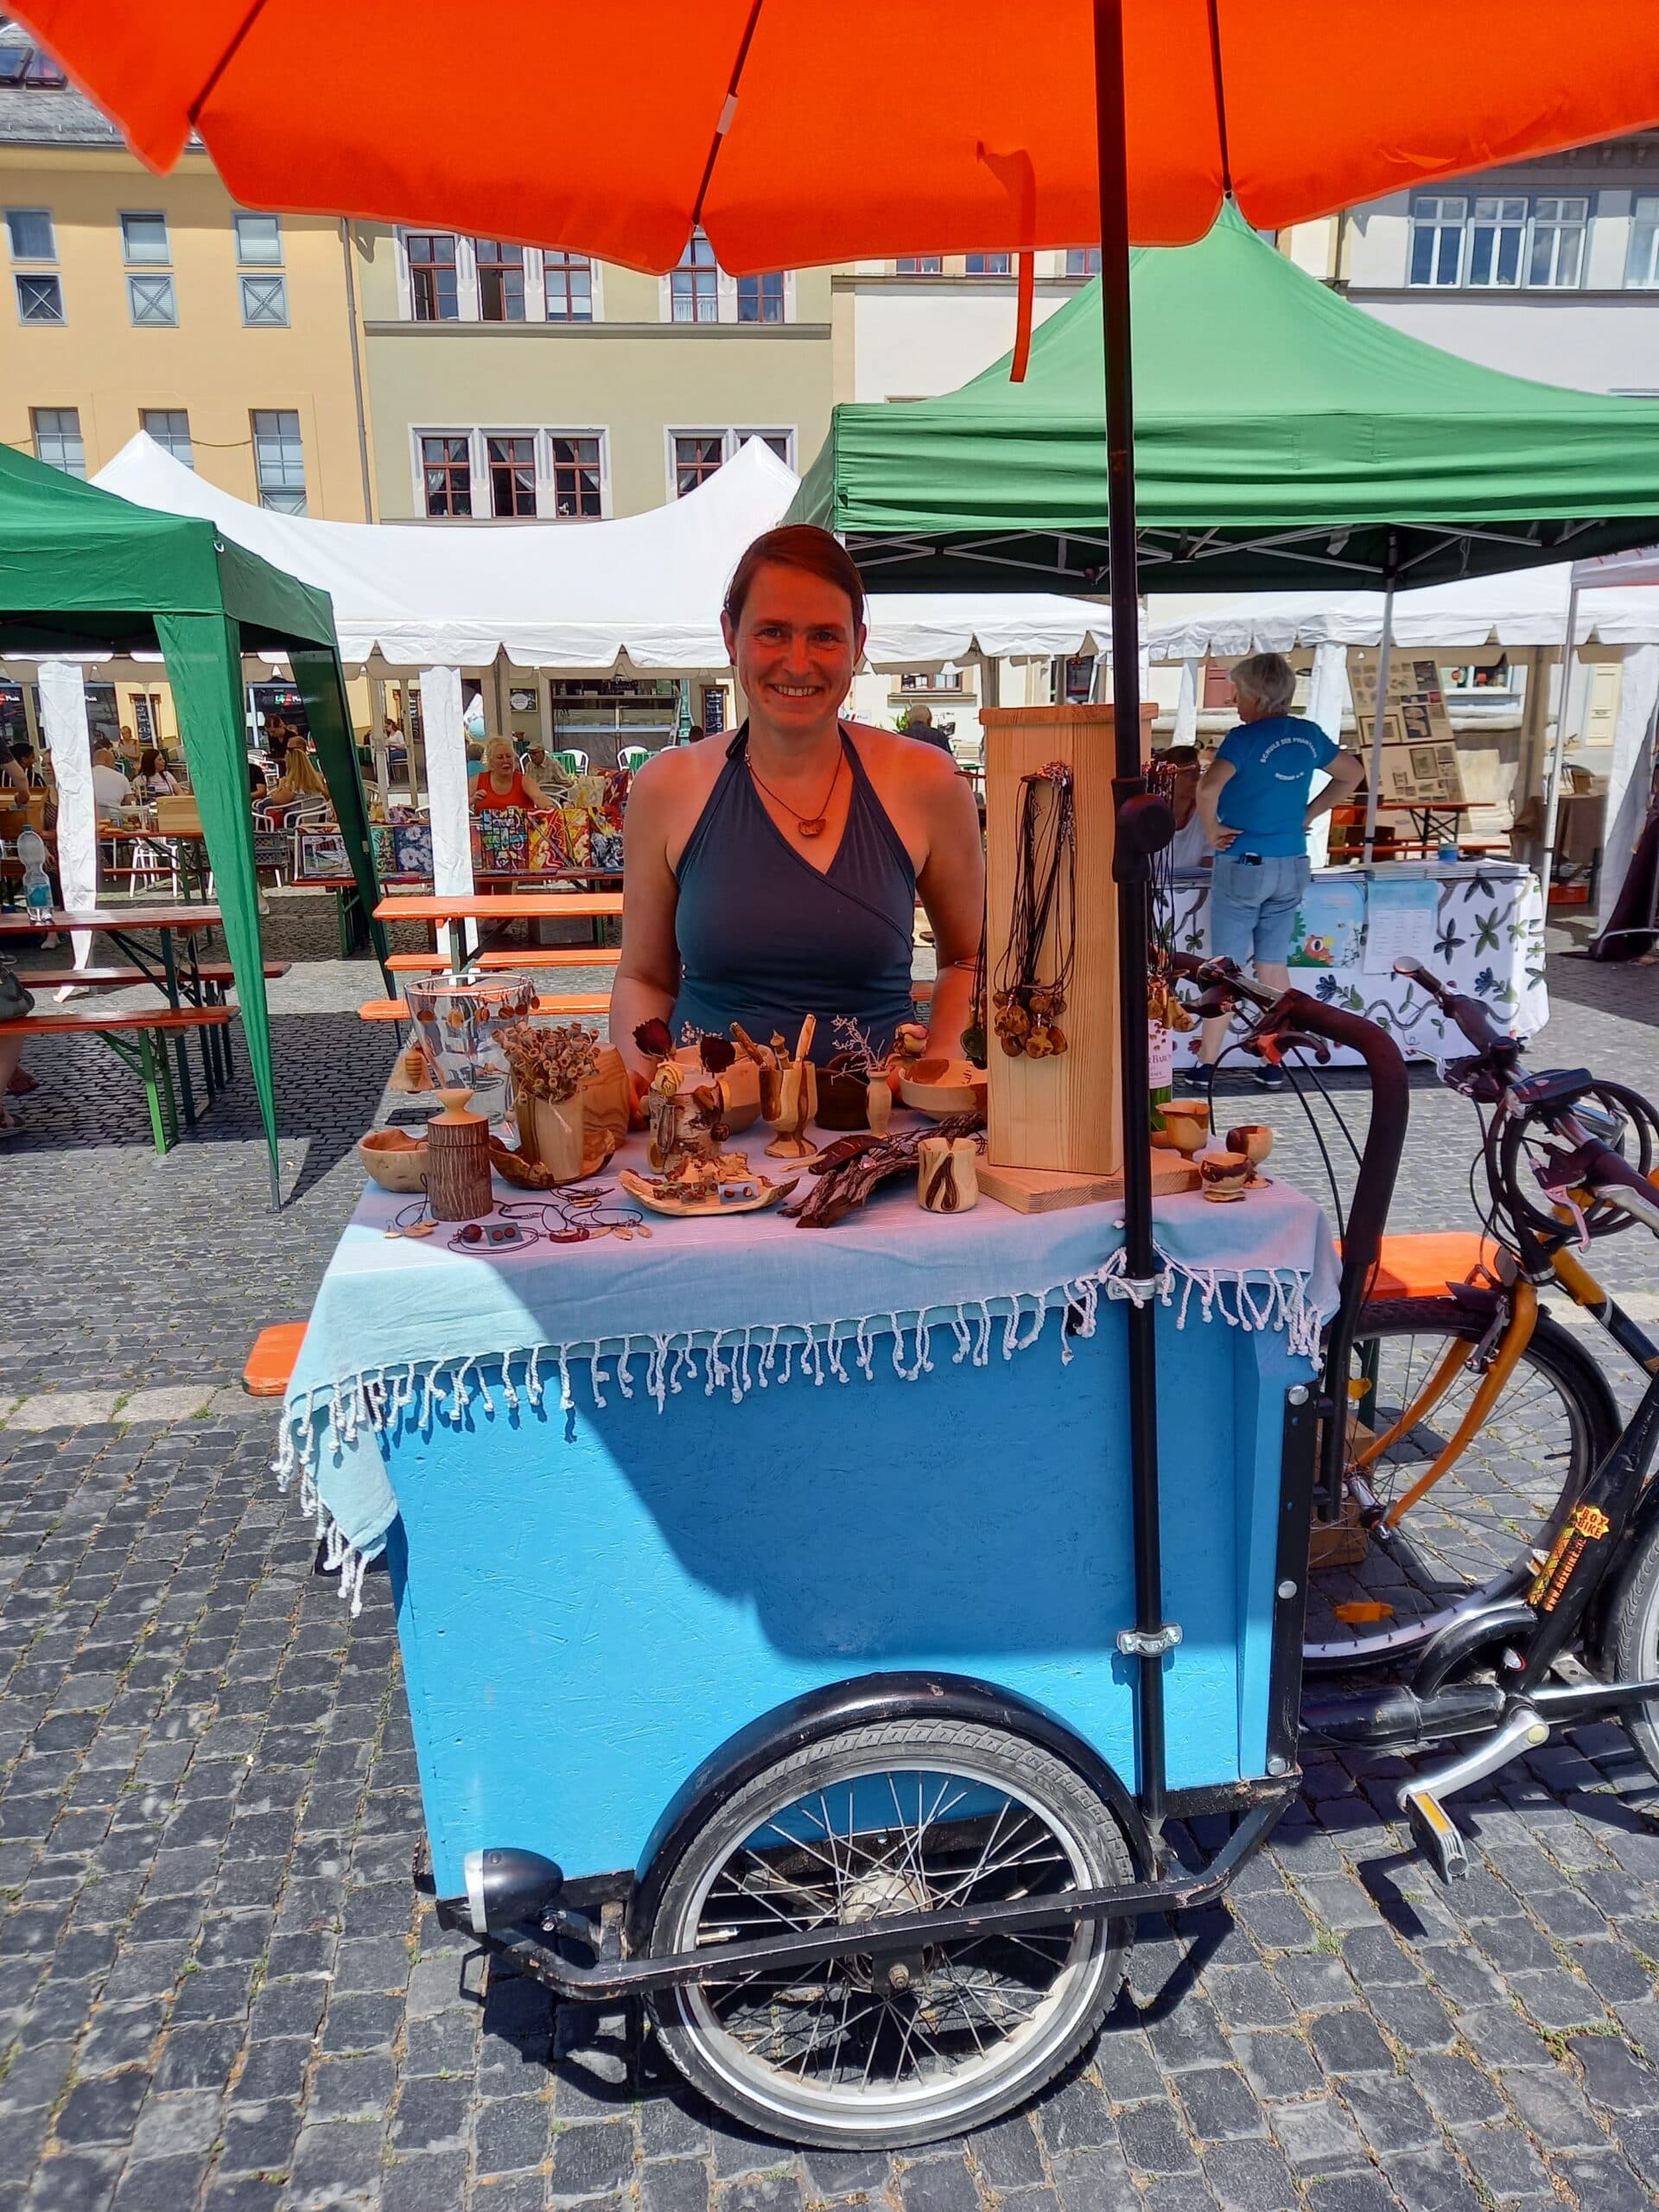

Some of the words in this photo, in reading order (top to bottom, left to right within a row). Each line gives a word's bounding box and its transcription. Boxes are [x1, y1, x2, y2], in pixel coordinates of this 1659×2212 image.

[1260, 741, 1281, 764] SCHULE
[1582, 1509, 1607, 1526] BOX
[1577, 1518, 1603, 1537] BIKE
